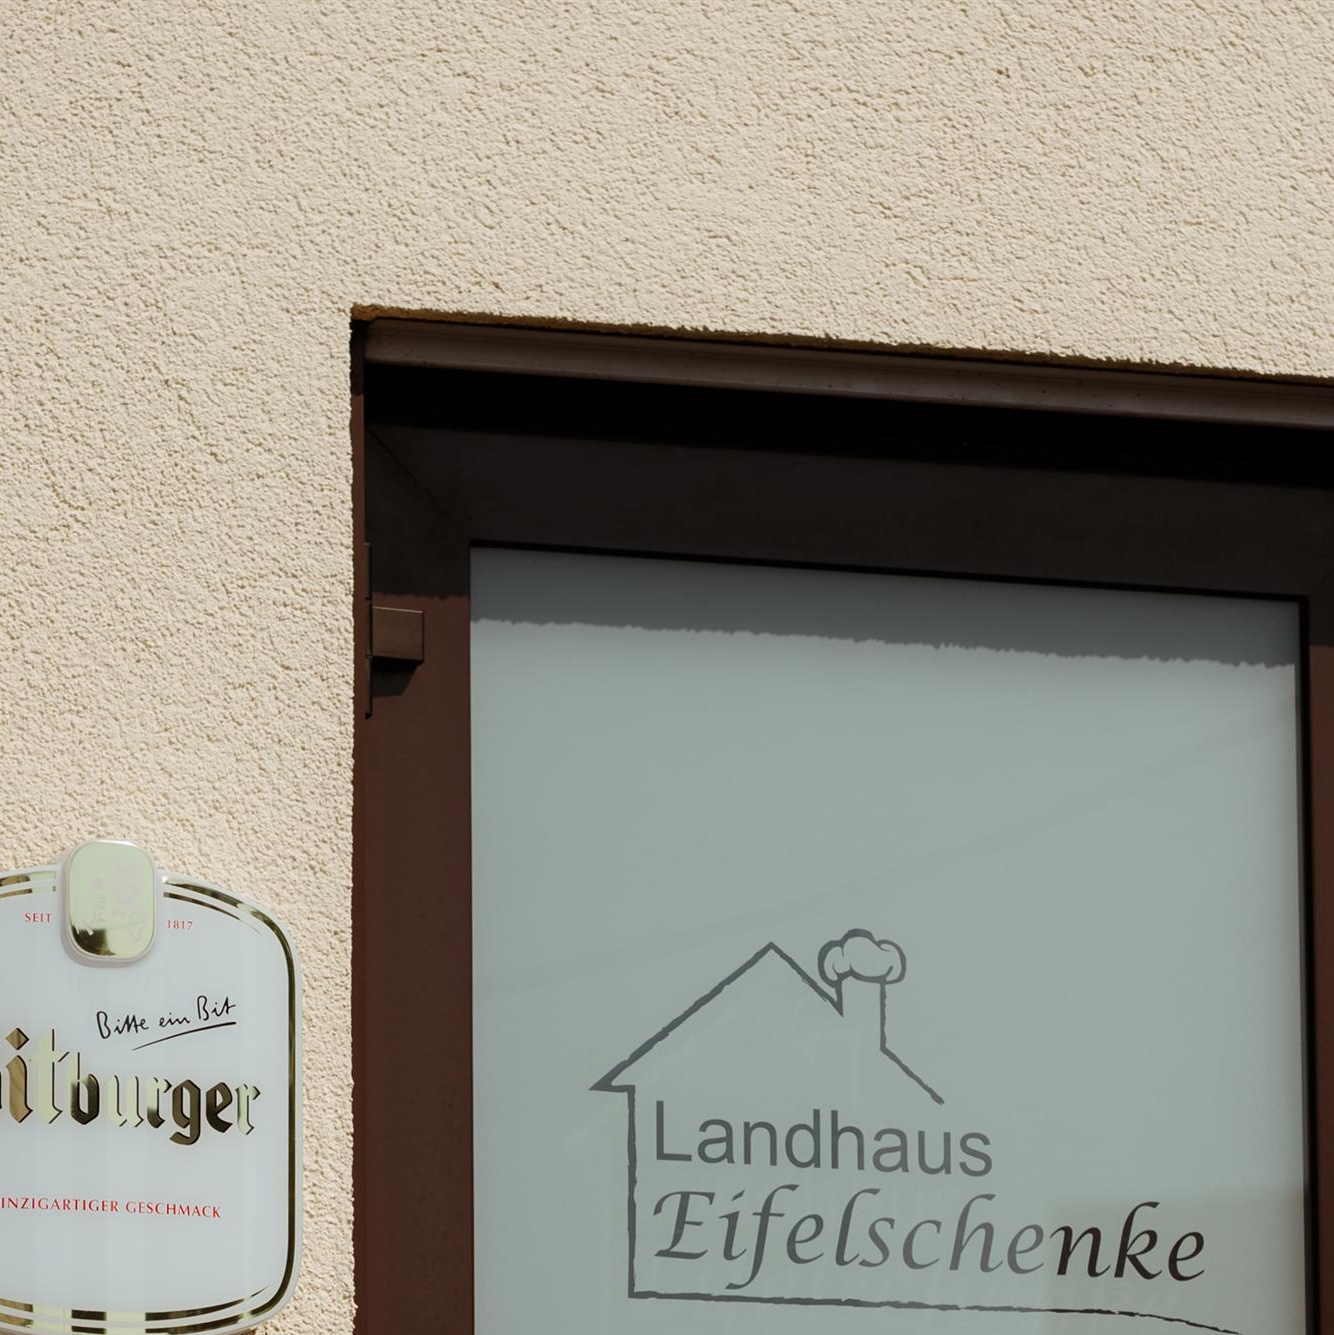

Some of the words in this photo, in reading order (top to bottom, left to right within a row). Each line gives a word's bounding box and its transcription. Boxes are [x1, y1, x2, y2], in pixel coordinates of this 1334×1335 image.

[23, 911, 52, 924] SEIT
[166, 918, 194, 931] 1817
[96, 1010, 150, 1039] Bitte
[159, 1012, 191, 1028] ein
[196, 995, 237, 1021] Bit
[654, 1100, 993, 1178] Landhaus
[125, 1200, 221, 1219] GESCHMACK
[652, 1184, 1207, 1292] Eifelschenke
